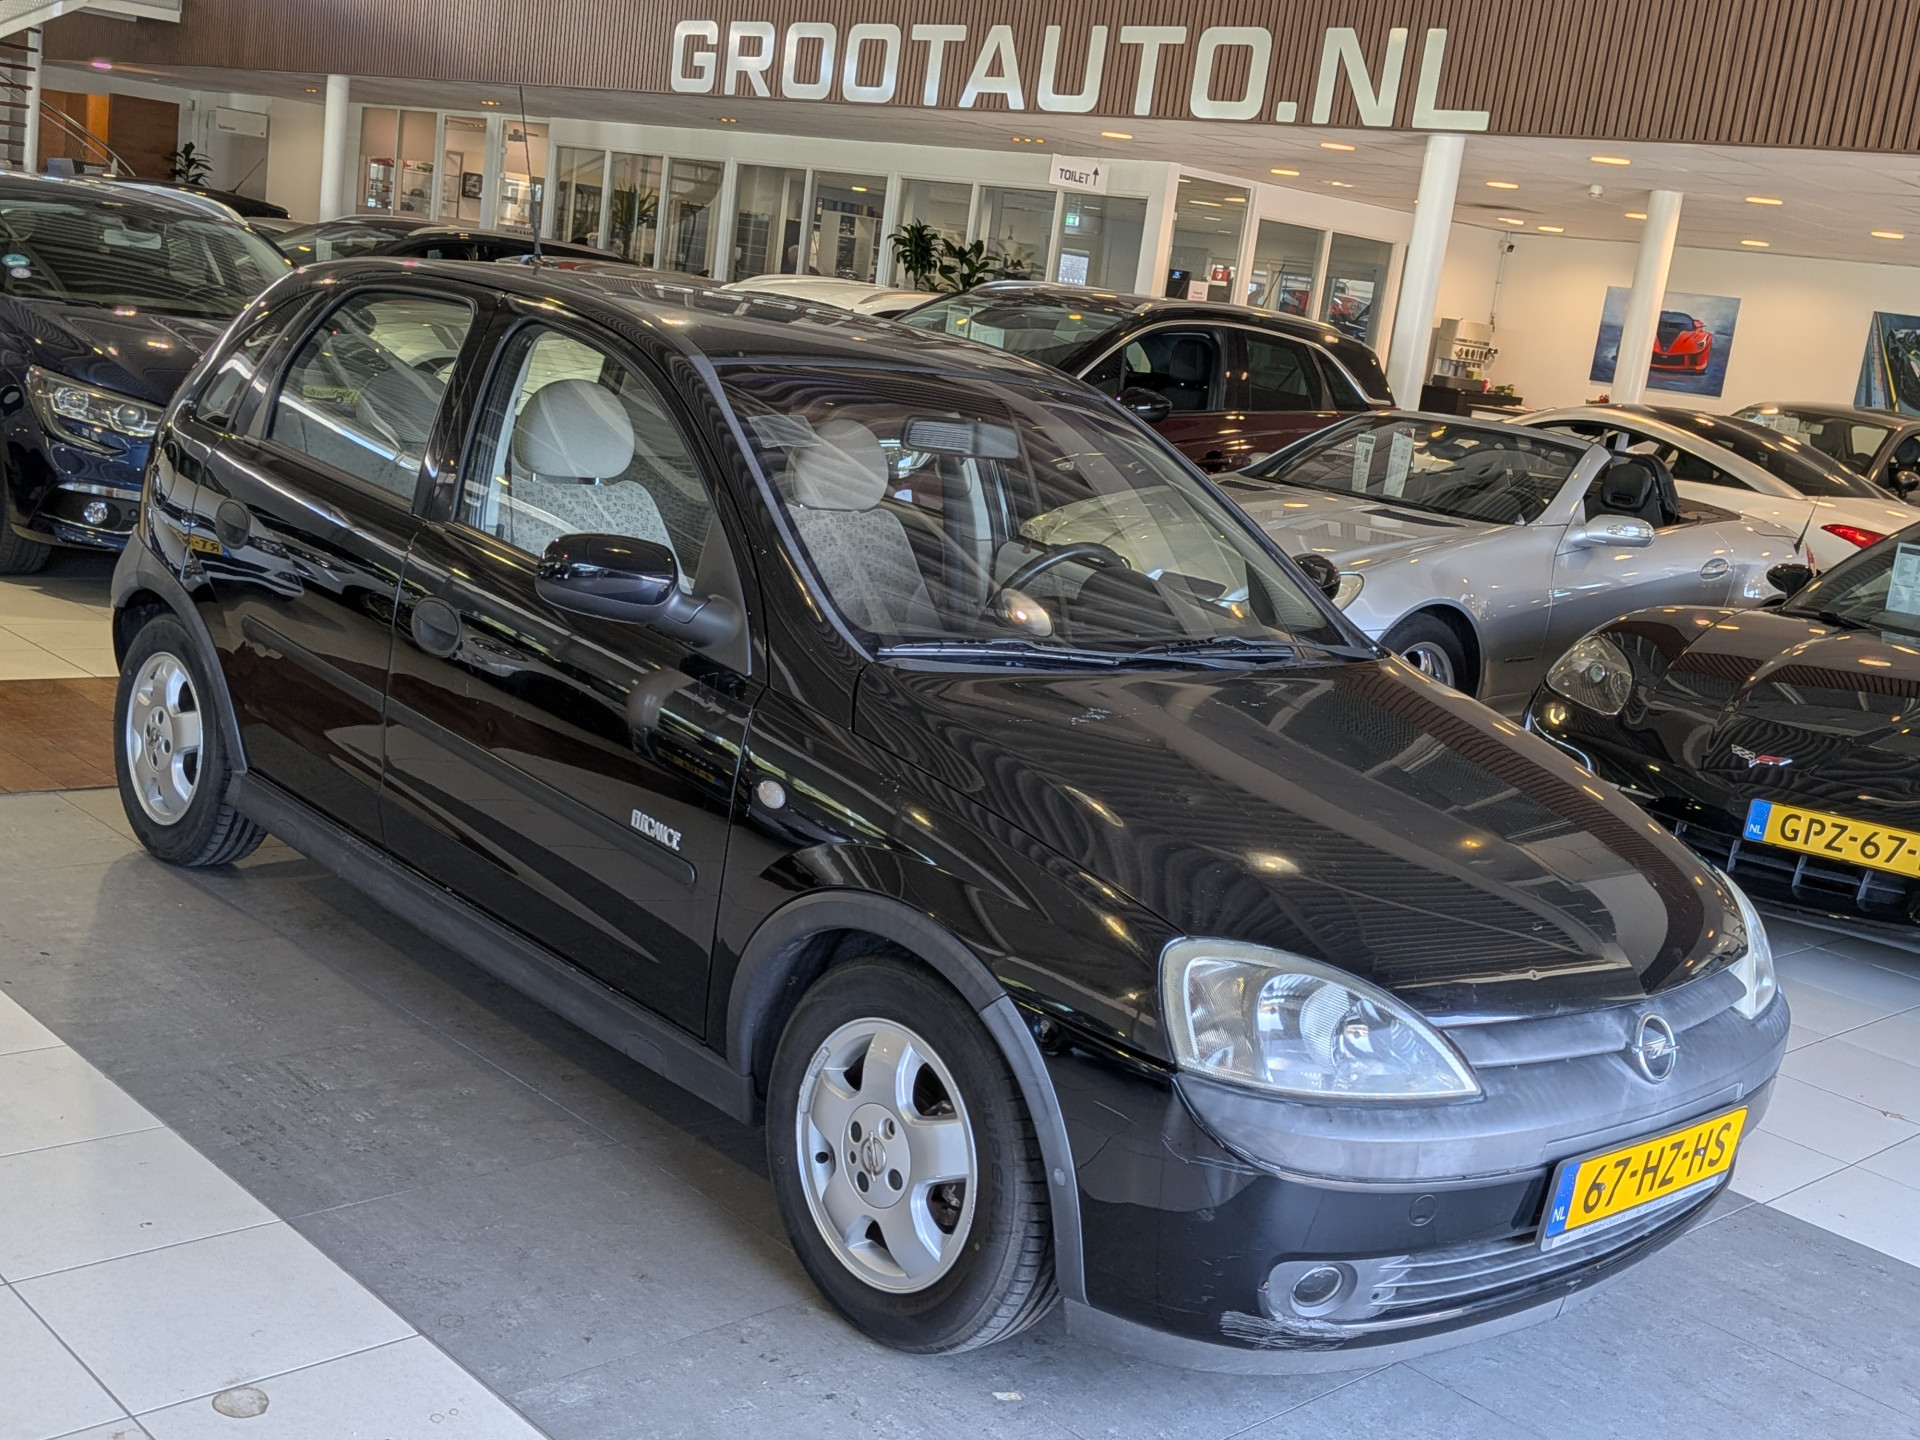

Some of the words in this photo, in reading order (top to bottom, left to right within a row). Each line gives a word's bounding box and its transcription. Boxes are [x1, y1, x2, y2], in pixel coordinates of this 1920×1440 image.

[671, 20, 1490, 132] GROOTAUTO.NL
[1059, 167, 1091, 185] TOILET
[1749, 823, 1763, 835] NL
[1780, 813, 1920, 872] GPZ-67-
[1583, 1121, 1732, 1214] 67-HZ-HS
[1552, 1205, 1566, 1224] NL
